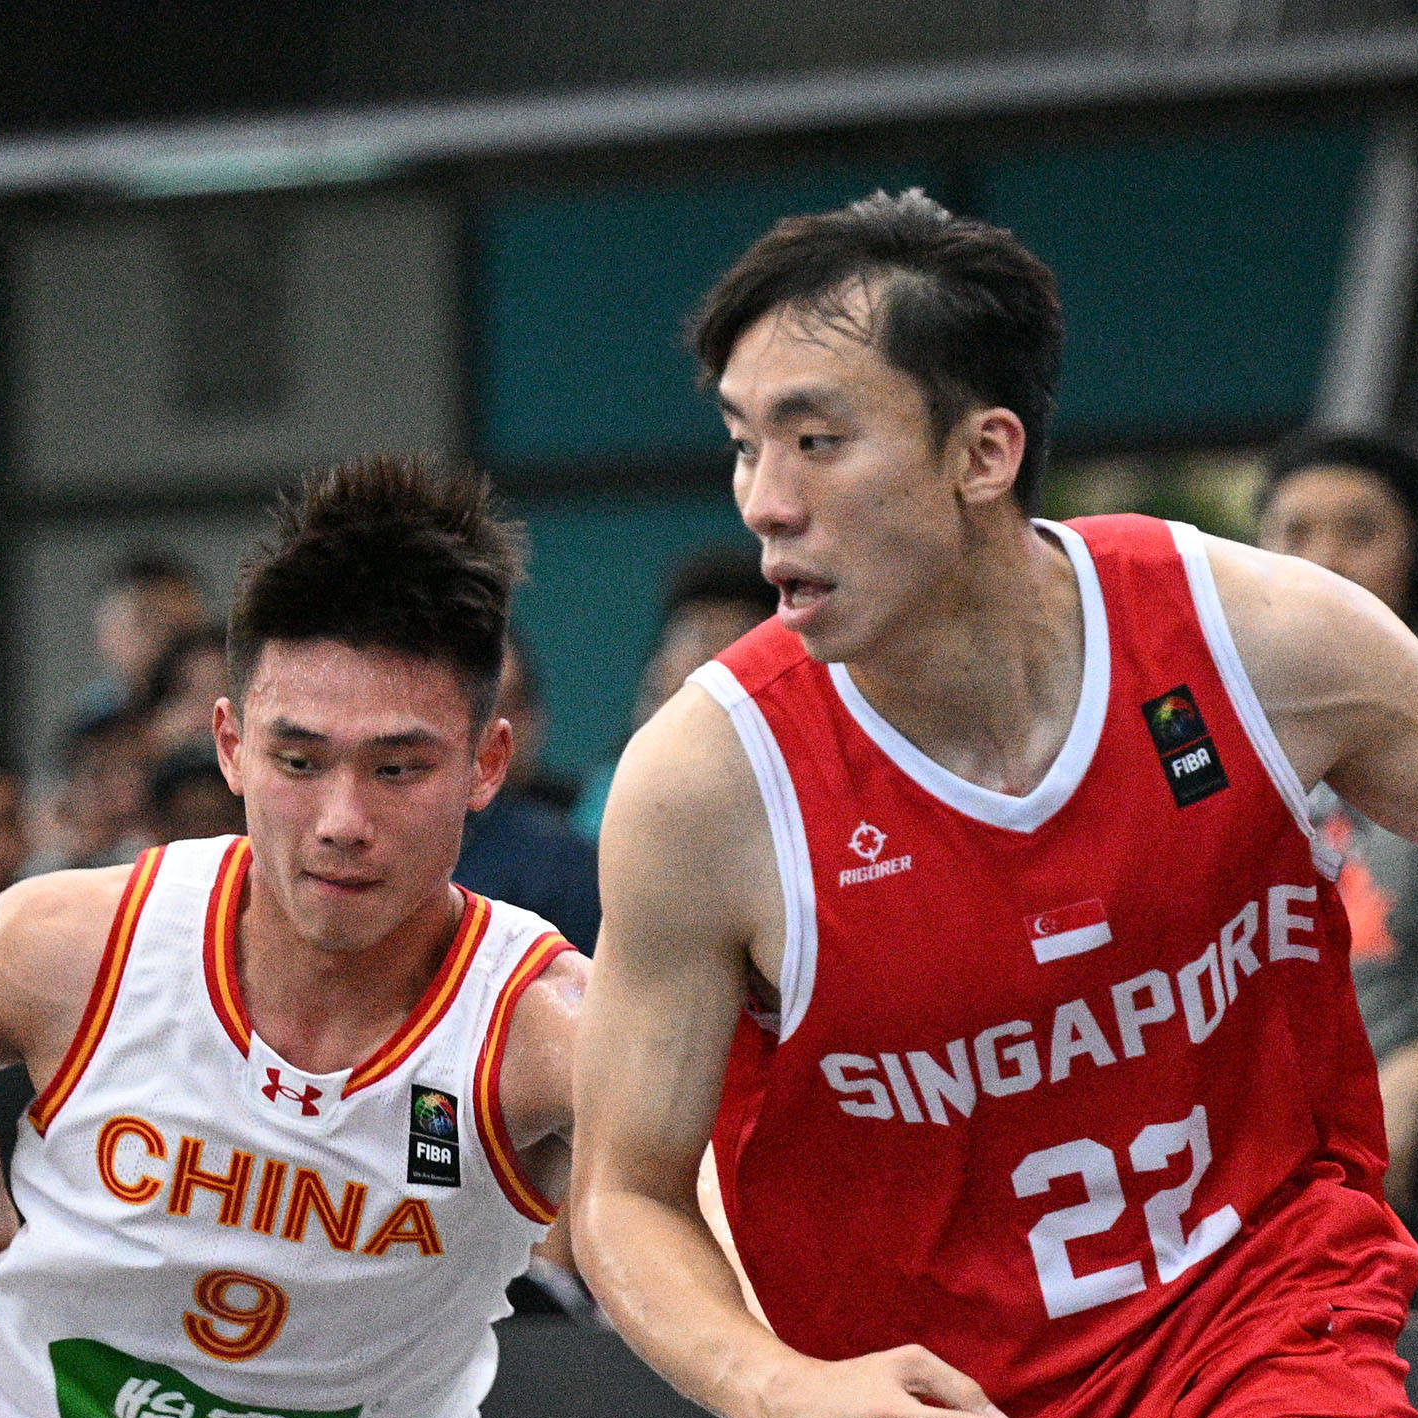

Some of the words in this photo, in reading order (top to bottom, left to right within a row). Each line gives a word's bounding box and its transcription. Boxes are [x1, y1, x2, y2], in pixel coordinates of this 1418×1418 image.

[1171, 747, 1212, 779] FIBA
[839, 854, 912, 888] RIGORER
[820, 884, 1321, 1126] SINGAPORE
[96, 1114, 445, 1257] CHINA
[415, 1141, 452, 1165] FIBA
[1011, 1104, 1242, 1320] 22
[183, 1269, 290, 1362] 9
